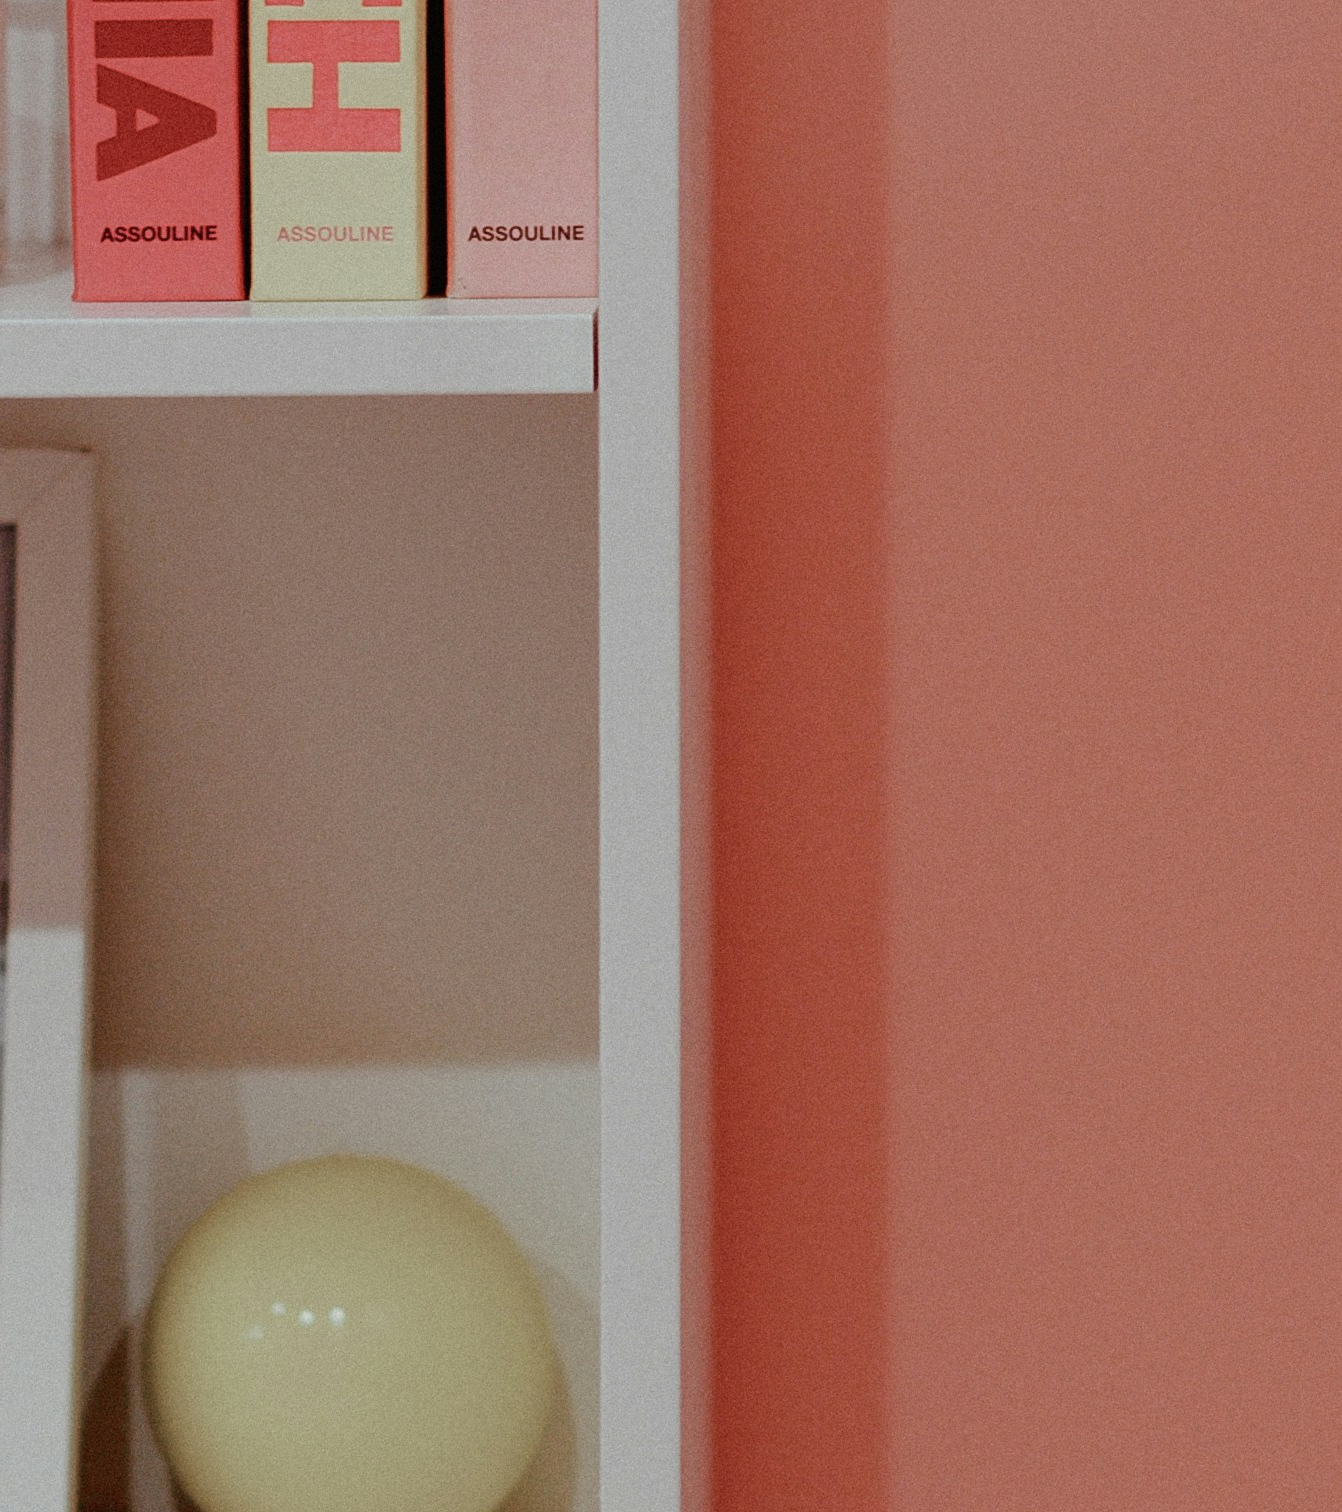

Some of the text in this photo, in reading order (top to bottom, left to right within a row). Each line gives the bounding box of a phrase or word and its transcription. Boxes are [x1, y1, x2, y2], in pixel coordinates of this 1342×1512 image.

[100, 224, 218, 243] ASSOULINE
[276, 225, 394, 243] ASSOULINE
[468, 224, 585, 243] ASSOULINE
